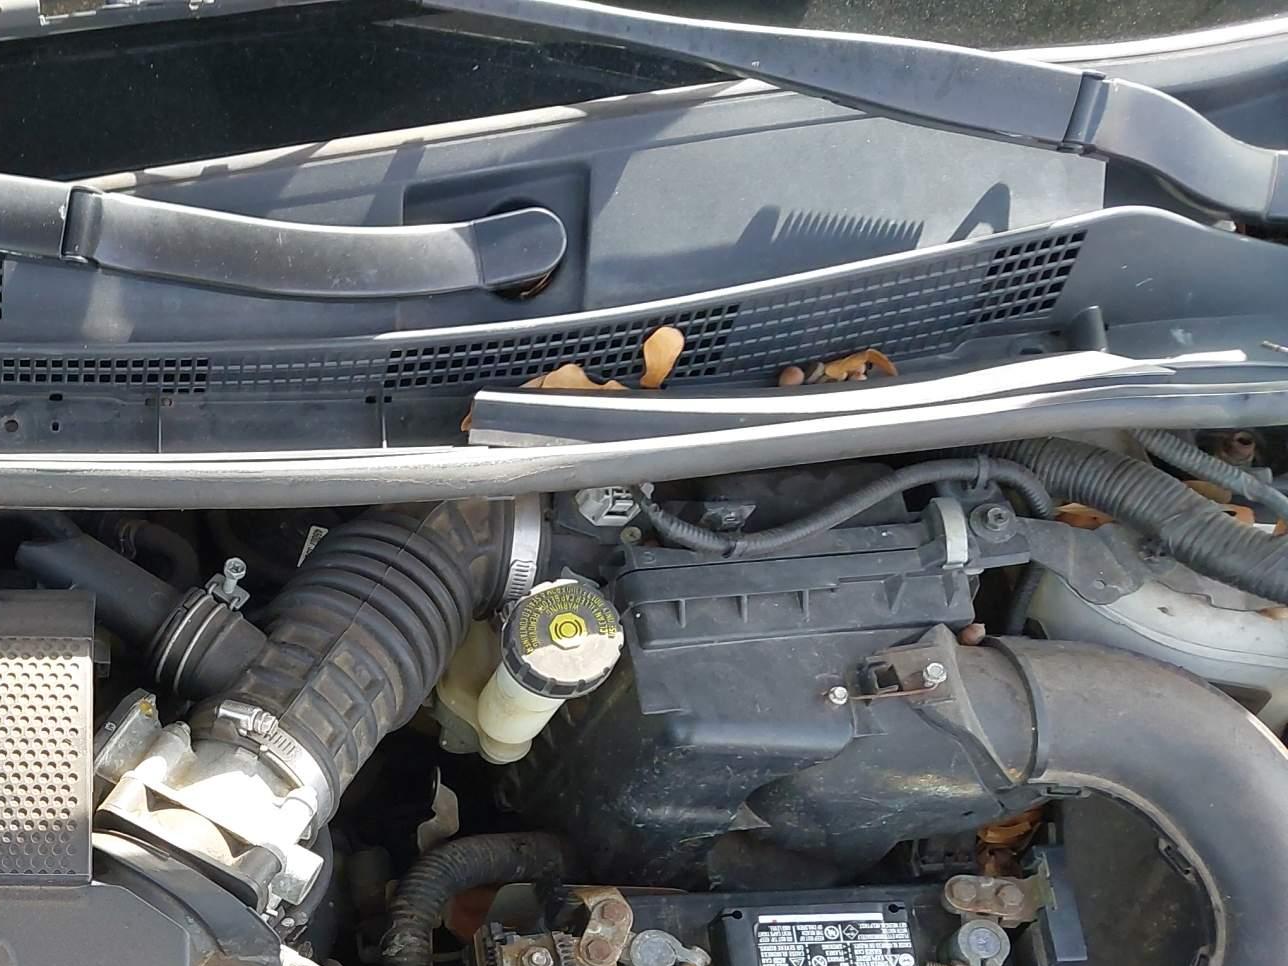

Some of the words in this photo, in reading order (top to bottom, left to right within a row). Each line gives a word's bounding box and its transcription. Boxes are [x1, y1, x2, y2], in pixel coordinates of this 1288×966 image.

[521, 595, 543, 618] SEALED
[545, 602, 579, 616] WARNING
[575, 595, 599, 612] FILLER
[527, 611, 540, 648] REMOVING
[594, 611, 607, 633] CLEAN
[519, 616, 534, 655] CONTAINER
